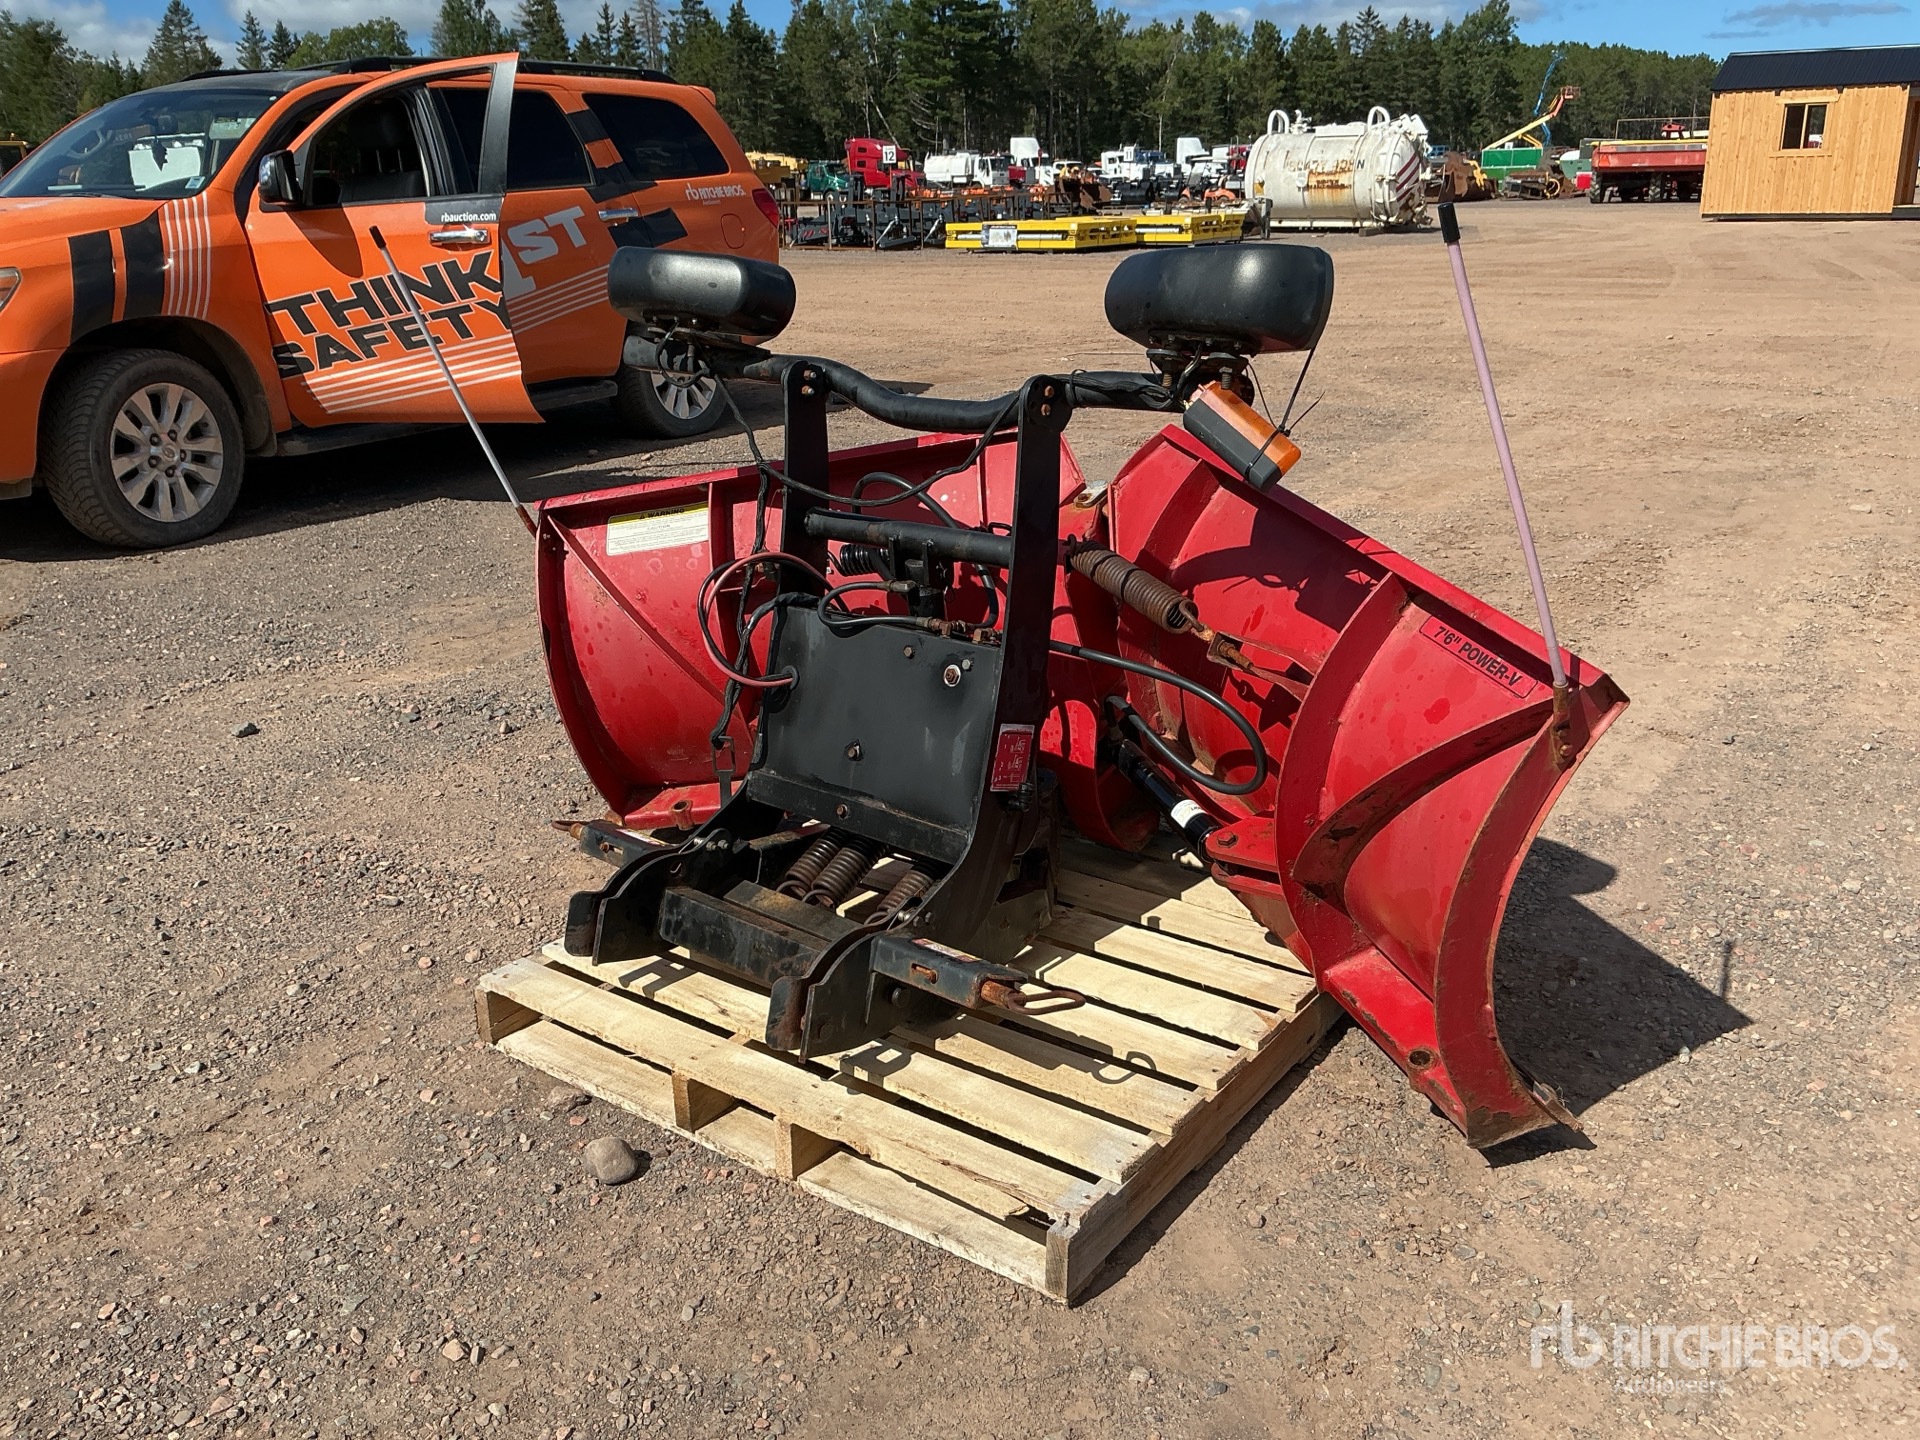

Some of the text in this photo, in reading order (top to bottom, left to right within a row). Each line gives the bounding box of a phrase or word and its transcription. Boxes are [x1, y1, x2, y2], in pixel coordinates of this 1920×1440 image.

[884, 151, 895, 161] 12
[698, 186, 725, 199] RITCHIE
[723, 184, 746, 197] BROS.
[440, 210, 497, 222] rbauction.com
[263, 249, 503, 336] THINK
[271, 299, 512, 379] SAFETY
[647, 508, 685, 518] WARNING
[1433, 625, 1522, 687] 7'6" POWER-V
